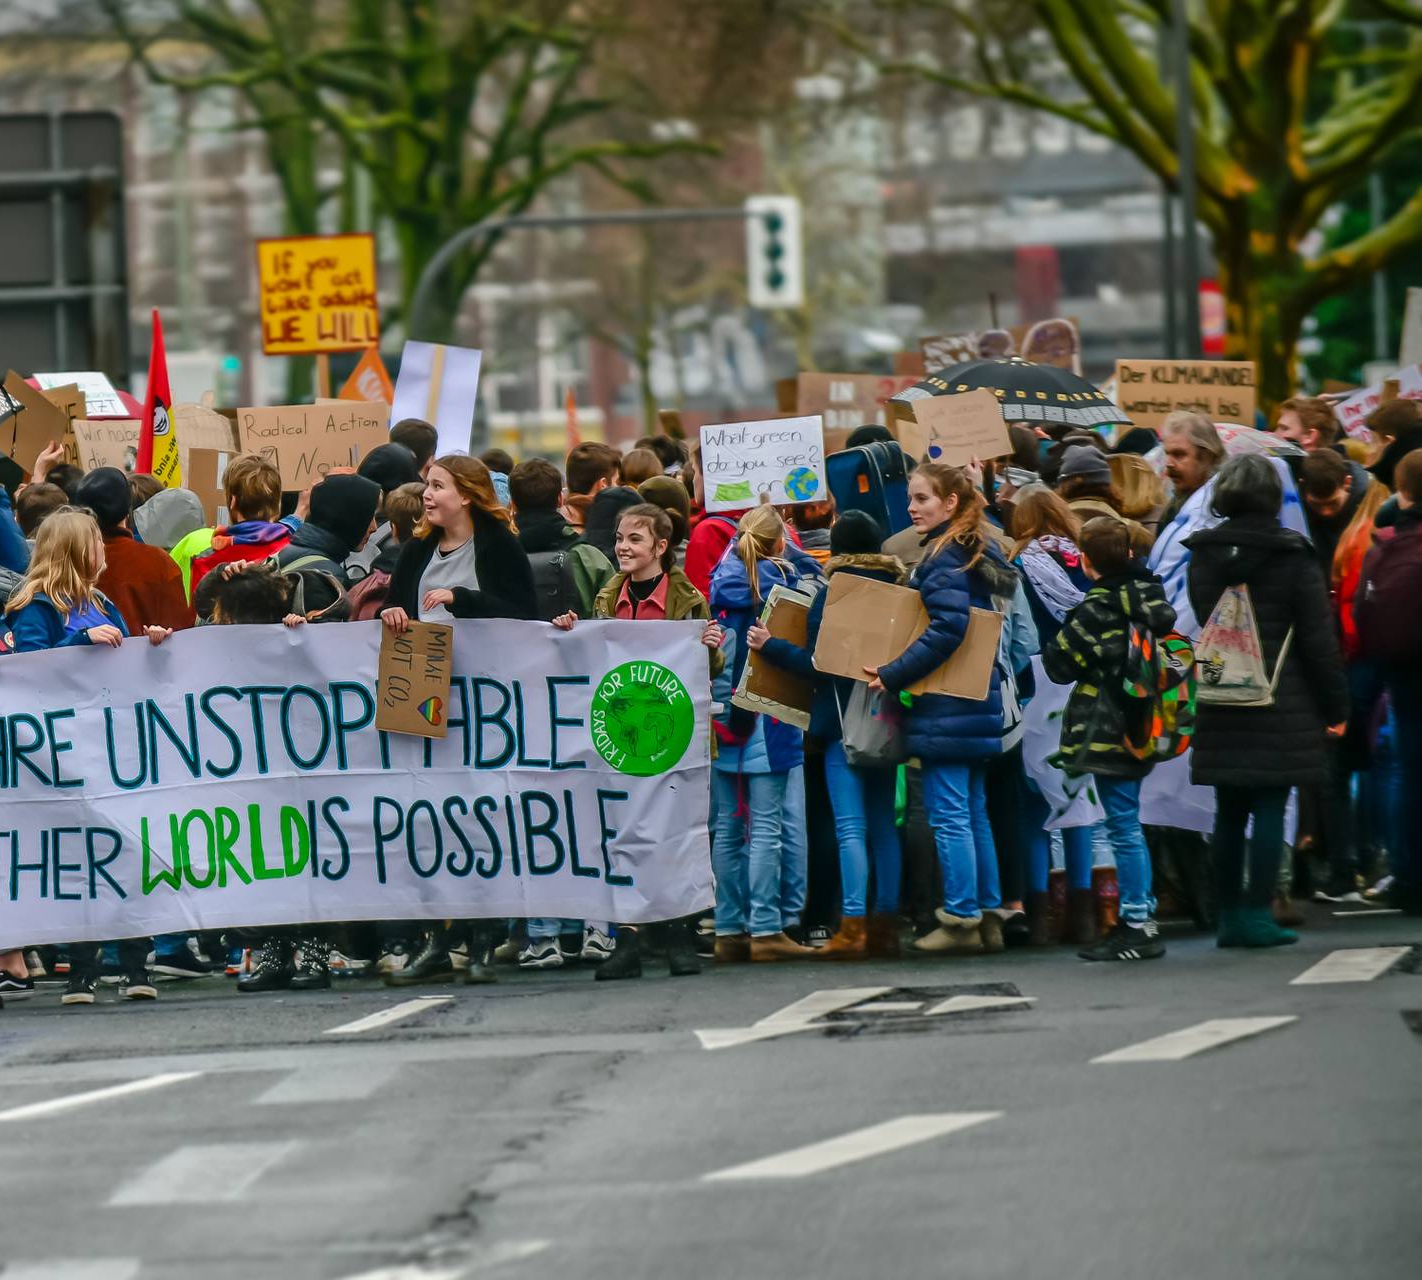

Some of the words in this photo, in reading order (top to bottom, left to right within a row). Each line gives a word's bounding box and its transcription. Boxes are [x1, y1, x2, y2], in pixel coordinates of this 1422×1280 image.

[264, 316, 305, 344] WE
[317, 312, 378, 343] WILL
[1120, 365, 1146, 384] Der
[1217, 397, 1240, 416] bis
[79, 423, 103, 441] Wir
[244, 413, 307, 440] Radical
[325, 412, 378, 433] Action
[705, 428, 750, 446] What
[747, 431, 802, 450] green
[707, 453, 730, 474] do
[730, 460, 766, 477] you
[757, 480, 782, 493] or
[599, 672, 624, 703] FOR
[630, 664, 685, 705] FUTURE
[104, 675, 590, 789] UNSTOPABLE
[593, 709, 626, 769] FRIDAYS
[141, 803, 310, 896] WORLD
[308, 796, 351, 881] IS
[373, 788, 634, 887] POSSIBLE
